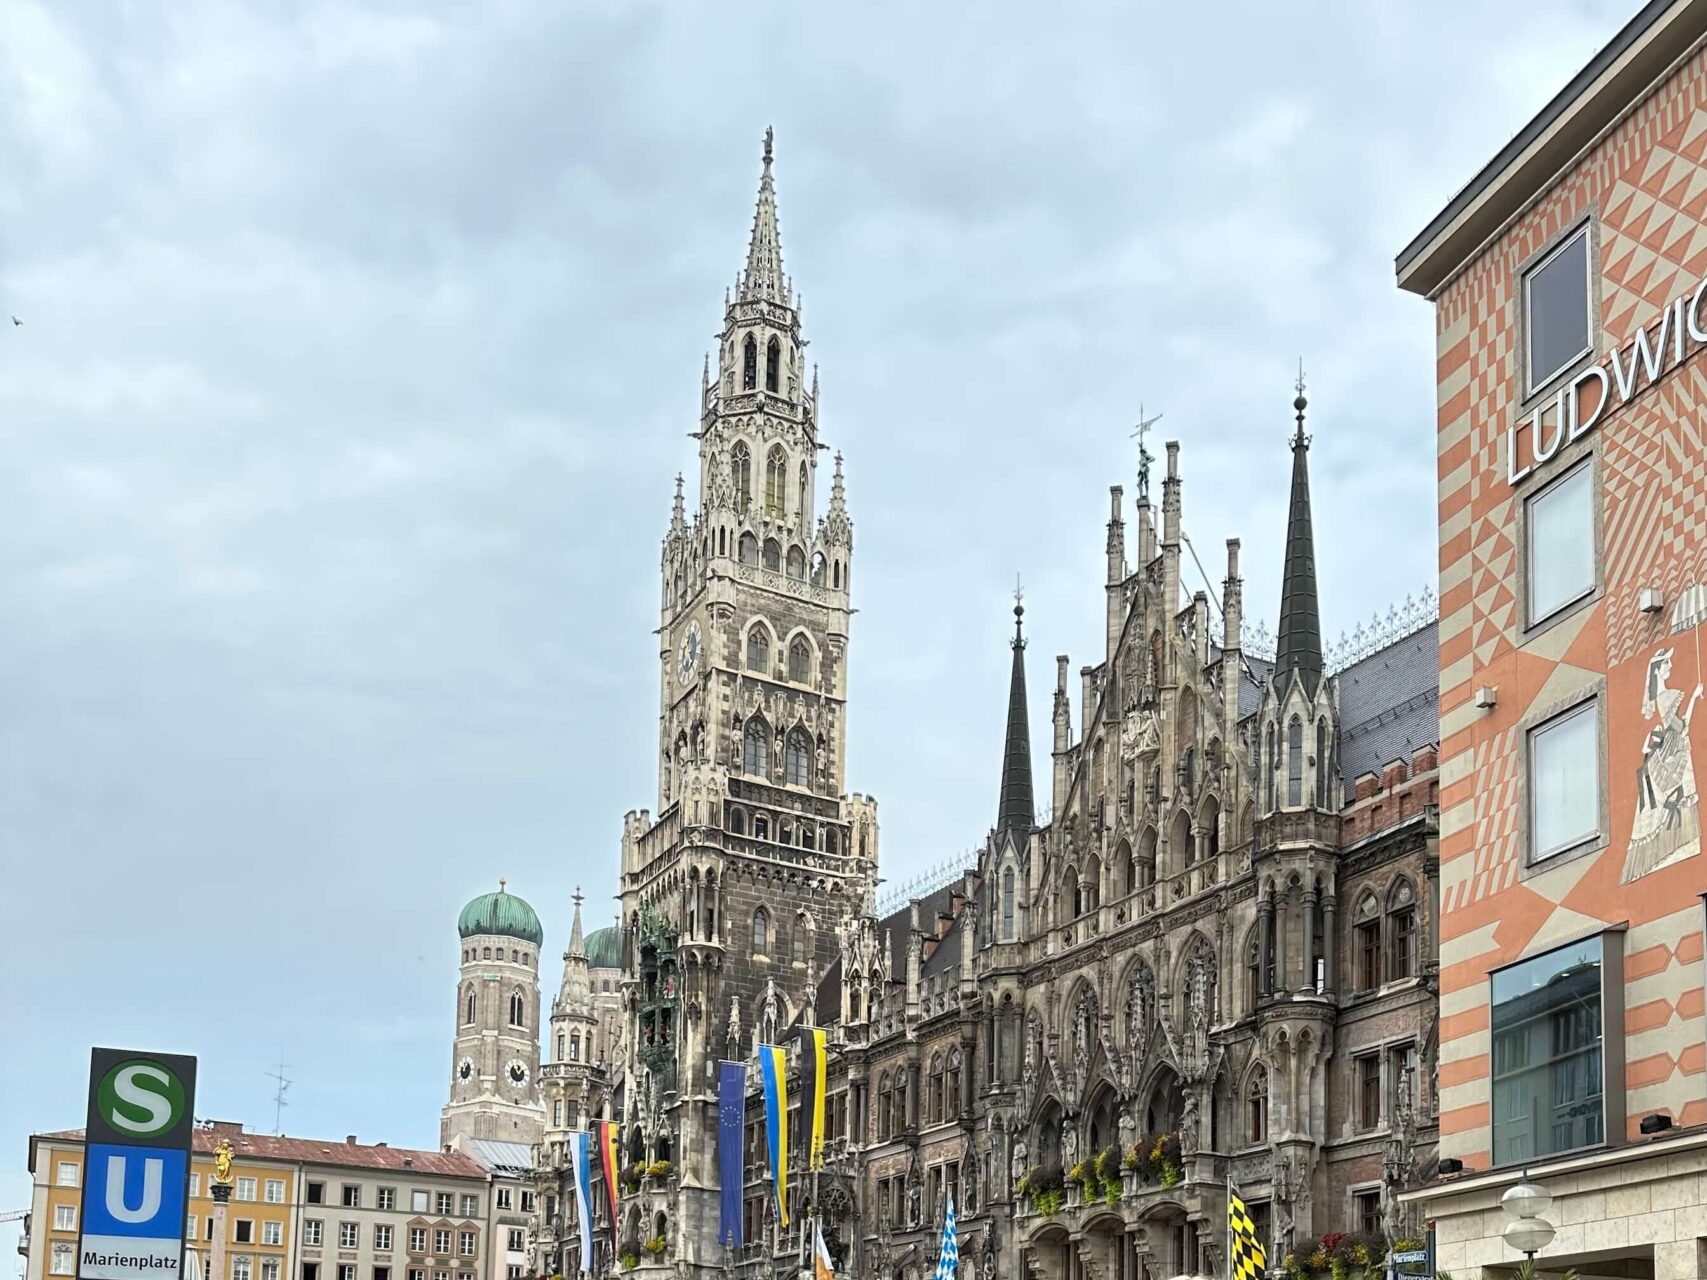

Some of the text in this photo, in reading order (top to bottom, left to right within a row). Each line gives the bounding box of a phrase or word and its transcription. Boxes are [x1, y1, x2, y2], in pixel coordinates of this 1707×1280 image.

[112, 1065, 172, 1132] S
[105, 1155, 164, 1223] U
[83, 1251, 177, 1270] Marienplatz
[1393, 1252, 1425, 1263] Marienplatz
